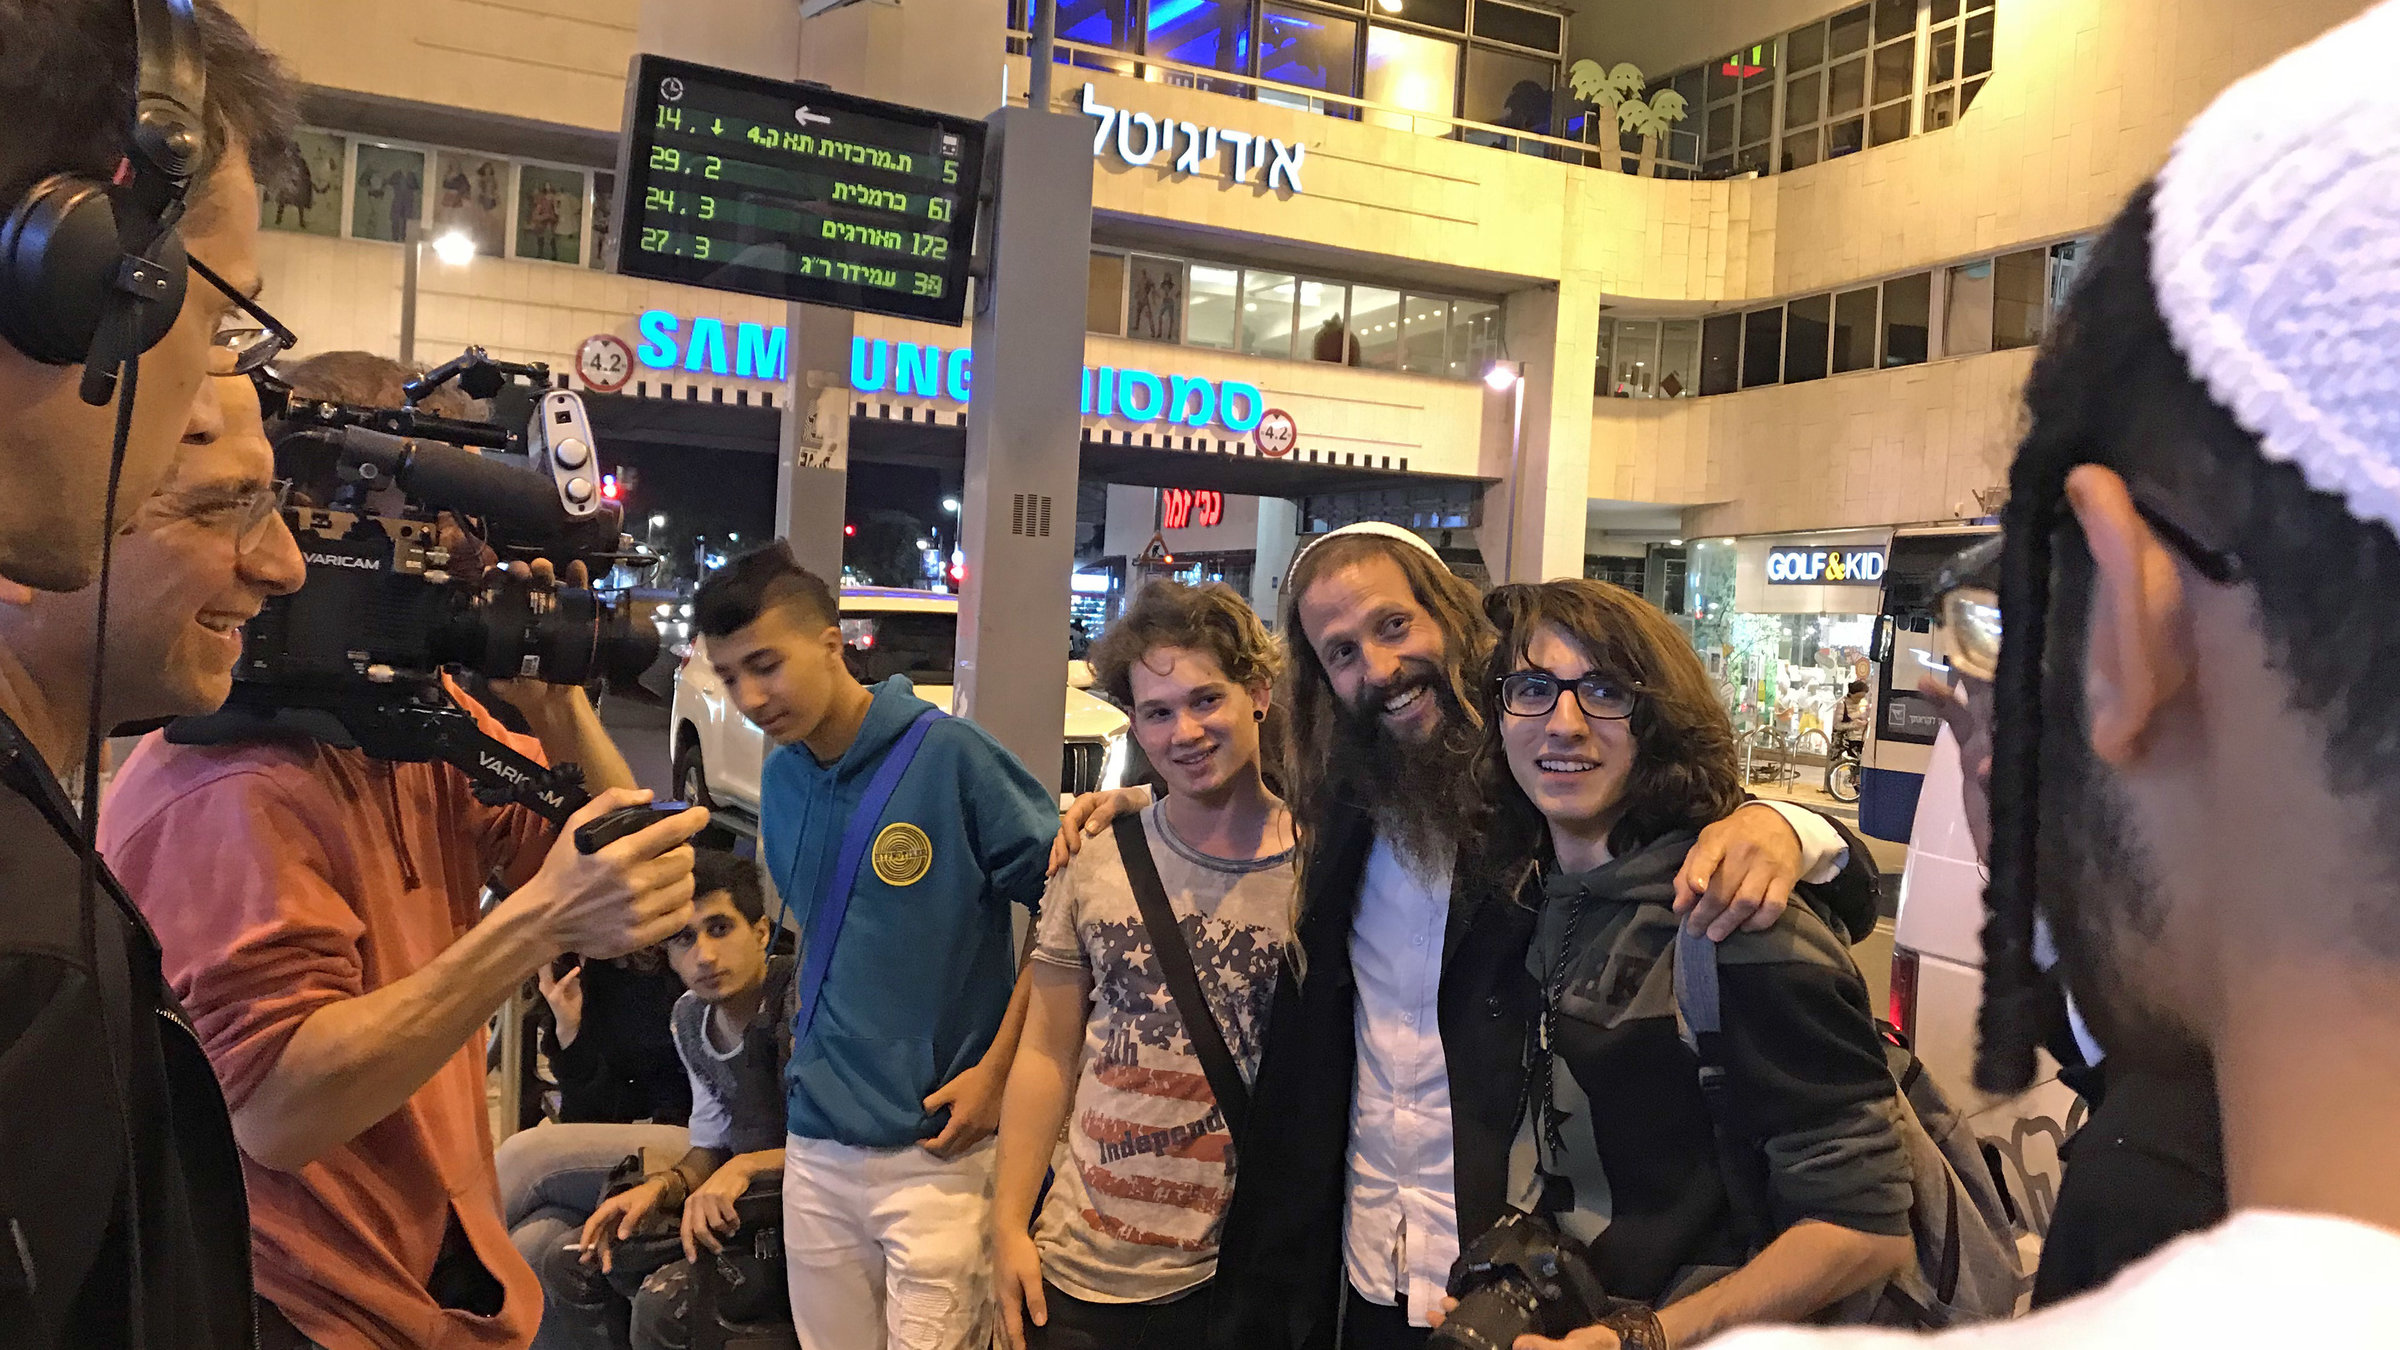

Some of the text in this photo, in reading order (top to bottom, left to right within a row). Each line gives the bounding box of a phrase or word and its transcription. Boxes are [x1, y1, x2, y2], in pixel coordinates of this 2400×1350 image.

[1082, 82, 1305, 192] אידיגיטל
[704, 155, 721, 180] 2
[943, 159, 959, 184] 5
[698, 195, 715, 219] 3
[832, 181, 907, 211] כרמלית
[693, 235, 710, 259] 3
[822, 219, 949, 260] האורגים 172
[837, 261, 896, 287] עמידר
[590, 353, 621, 372] 4.2
[637, 308, 971, 403] SAMUNG
[1265, 425, 1288, 441] 4.2
[302, 551, 380, 570] VARICAM
